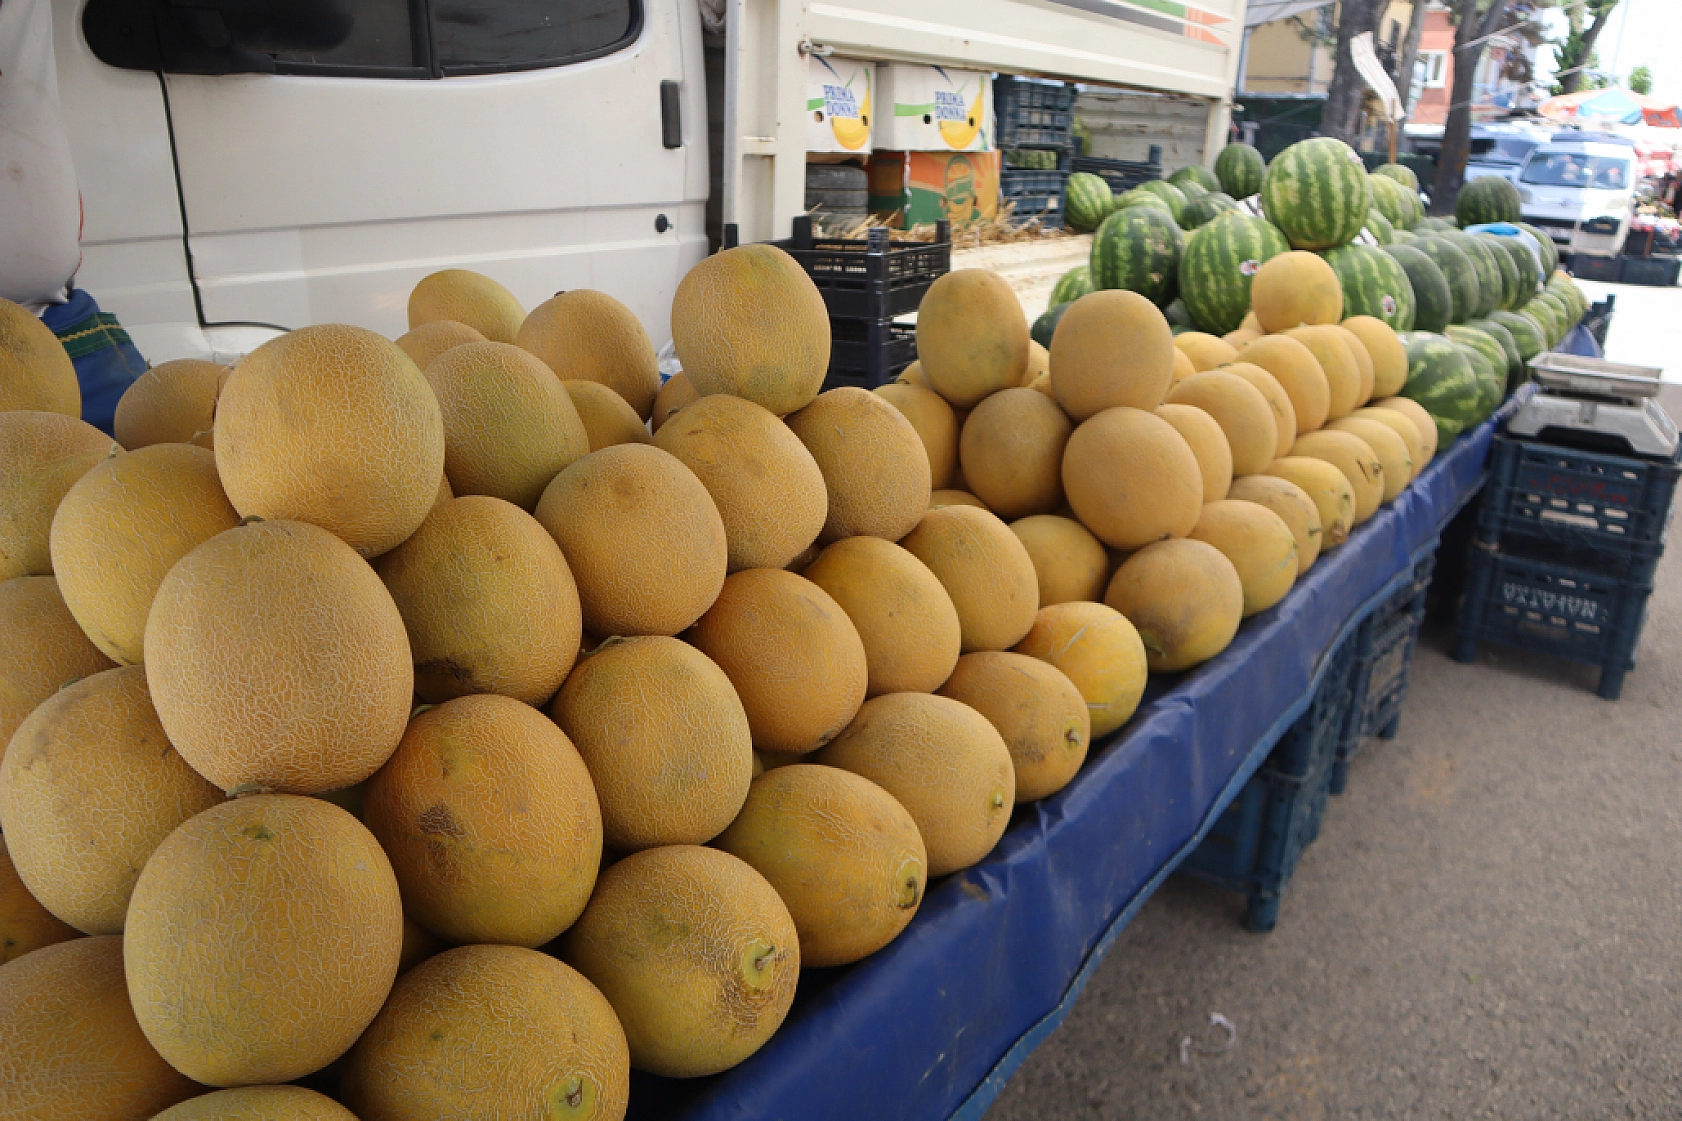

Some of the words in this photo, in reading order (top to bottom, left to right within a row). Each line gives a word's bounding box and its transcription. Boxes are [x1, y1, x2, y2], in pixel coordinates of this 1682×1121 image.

[823, 85, 855, 102] PRIMA
[935, 91, 965, 106] PRIMA
[826, 101, 859, 118] DONNA
[935, 106, 967, 121] DONNA
